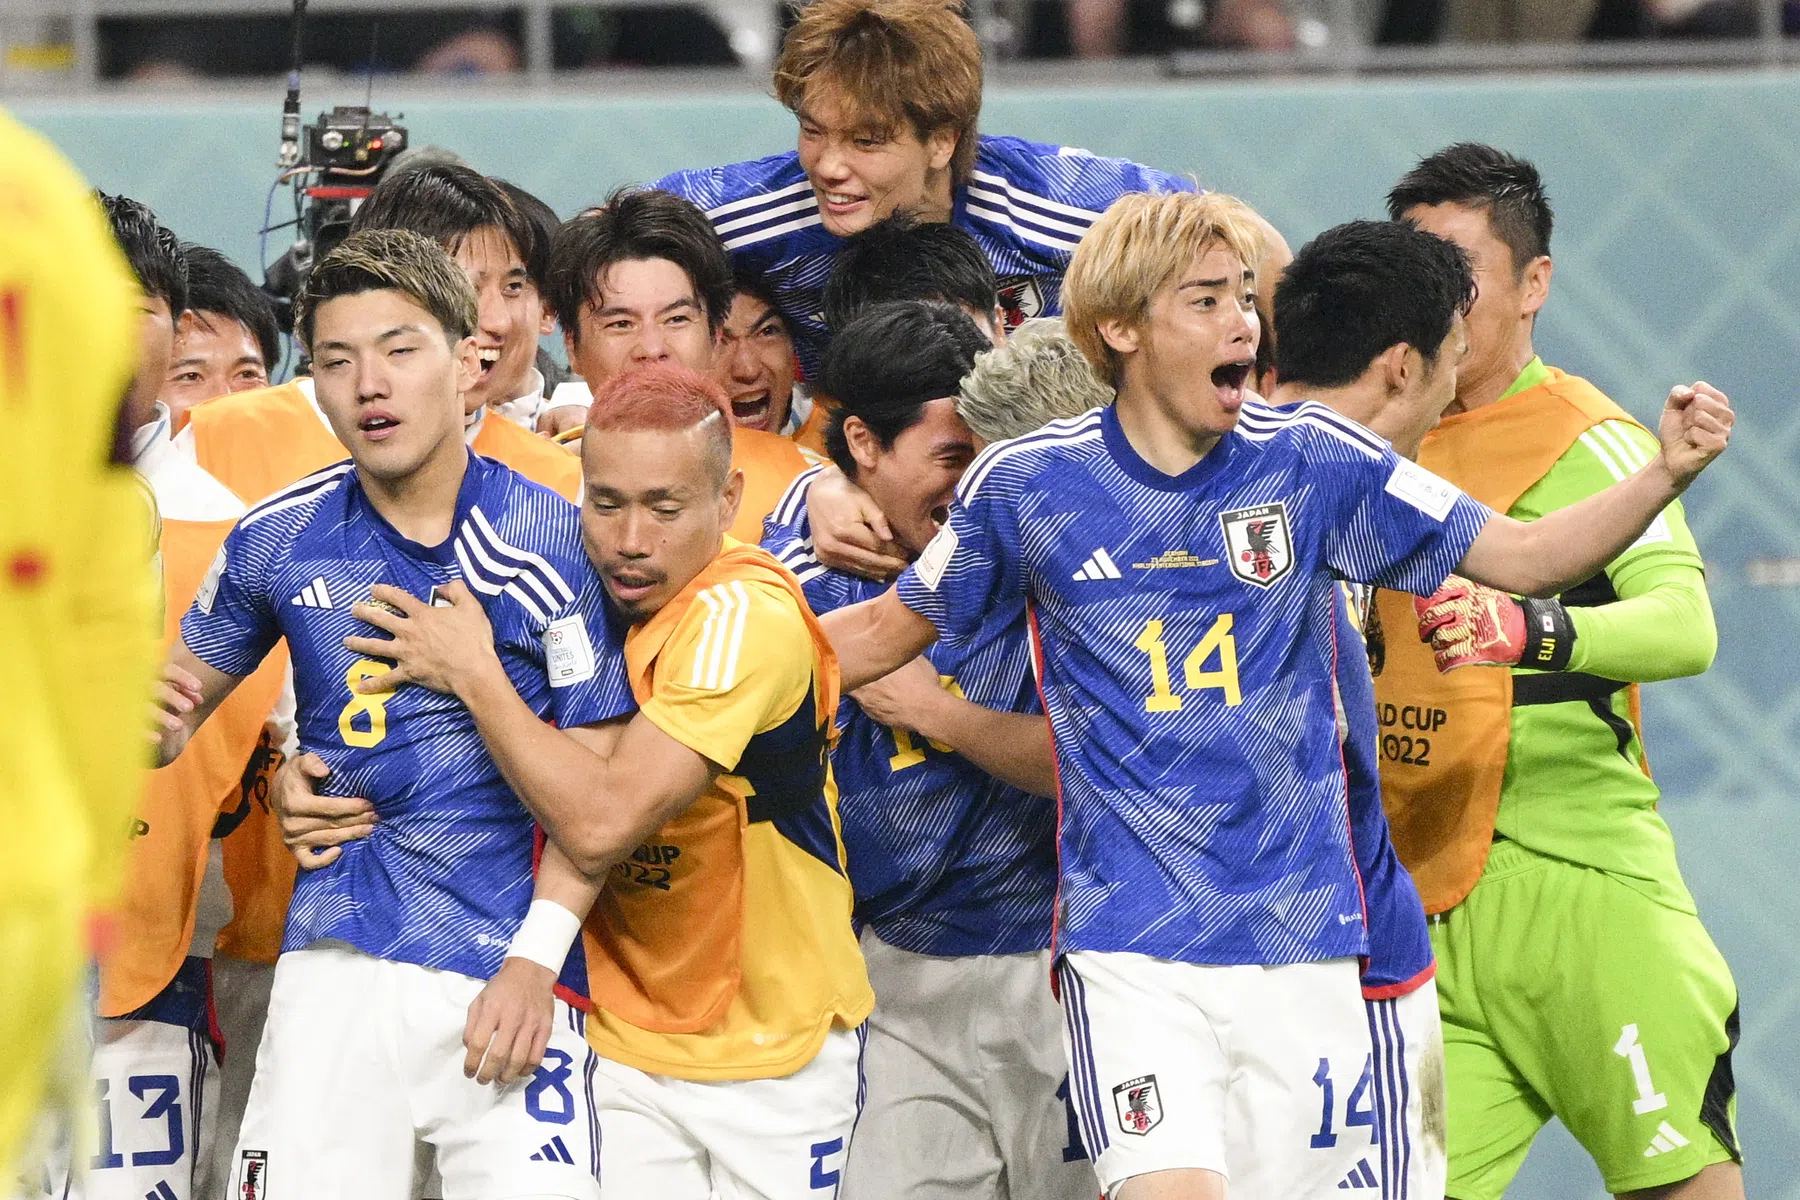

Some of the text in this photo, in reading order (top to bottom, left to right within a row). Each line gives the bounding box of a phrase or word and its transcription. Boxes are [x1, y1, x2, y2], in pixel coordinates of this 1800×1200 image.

[1236, 507, 1270, 519] JAPAN
[1250, 560, 1277, 575] JFA
[1134, 613, 1242, 713] 14
[1538, 638, 1556, 661] EIJI
[338, 659, 396, 749] 8
[1402, 706, 1447, 732] CUP
[1380, 734, 1431, 767] 022
[525, 1047, 575, 1125] 8
[1121, 1077, 1146, 1090] JAPAN
[1613, 1023, 1668, 1115] 1
[90, 1075, 184, 1170] 13
[1310, 1052, 1379, 1148] 14
